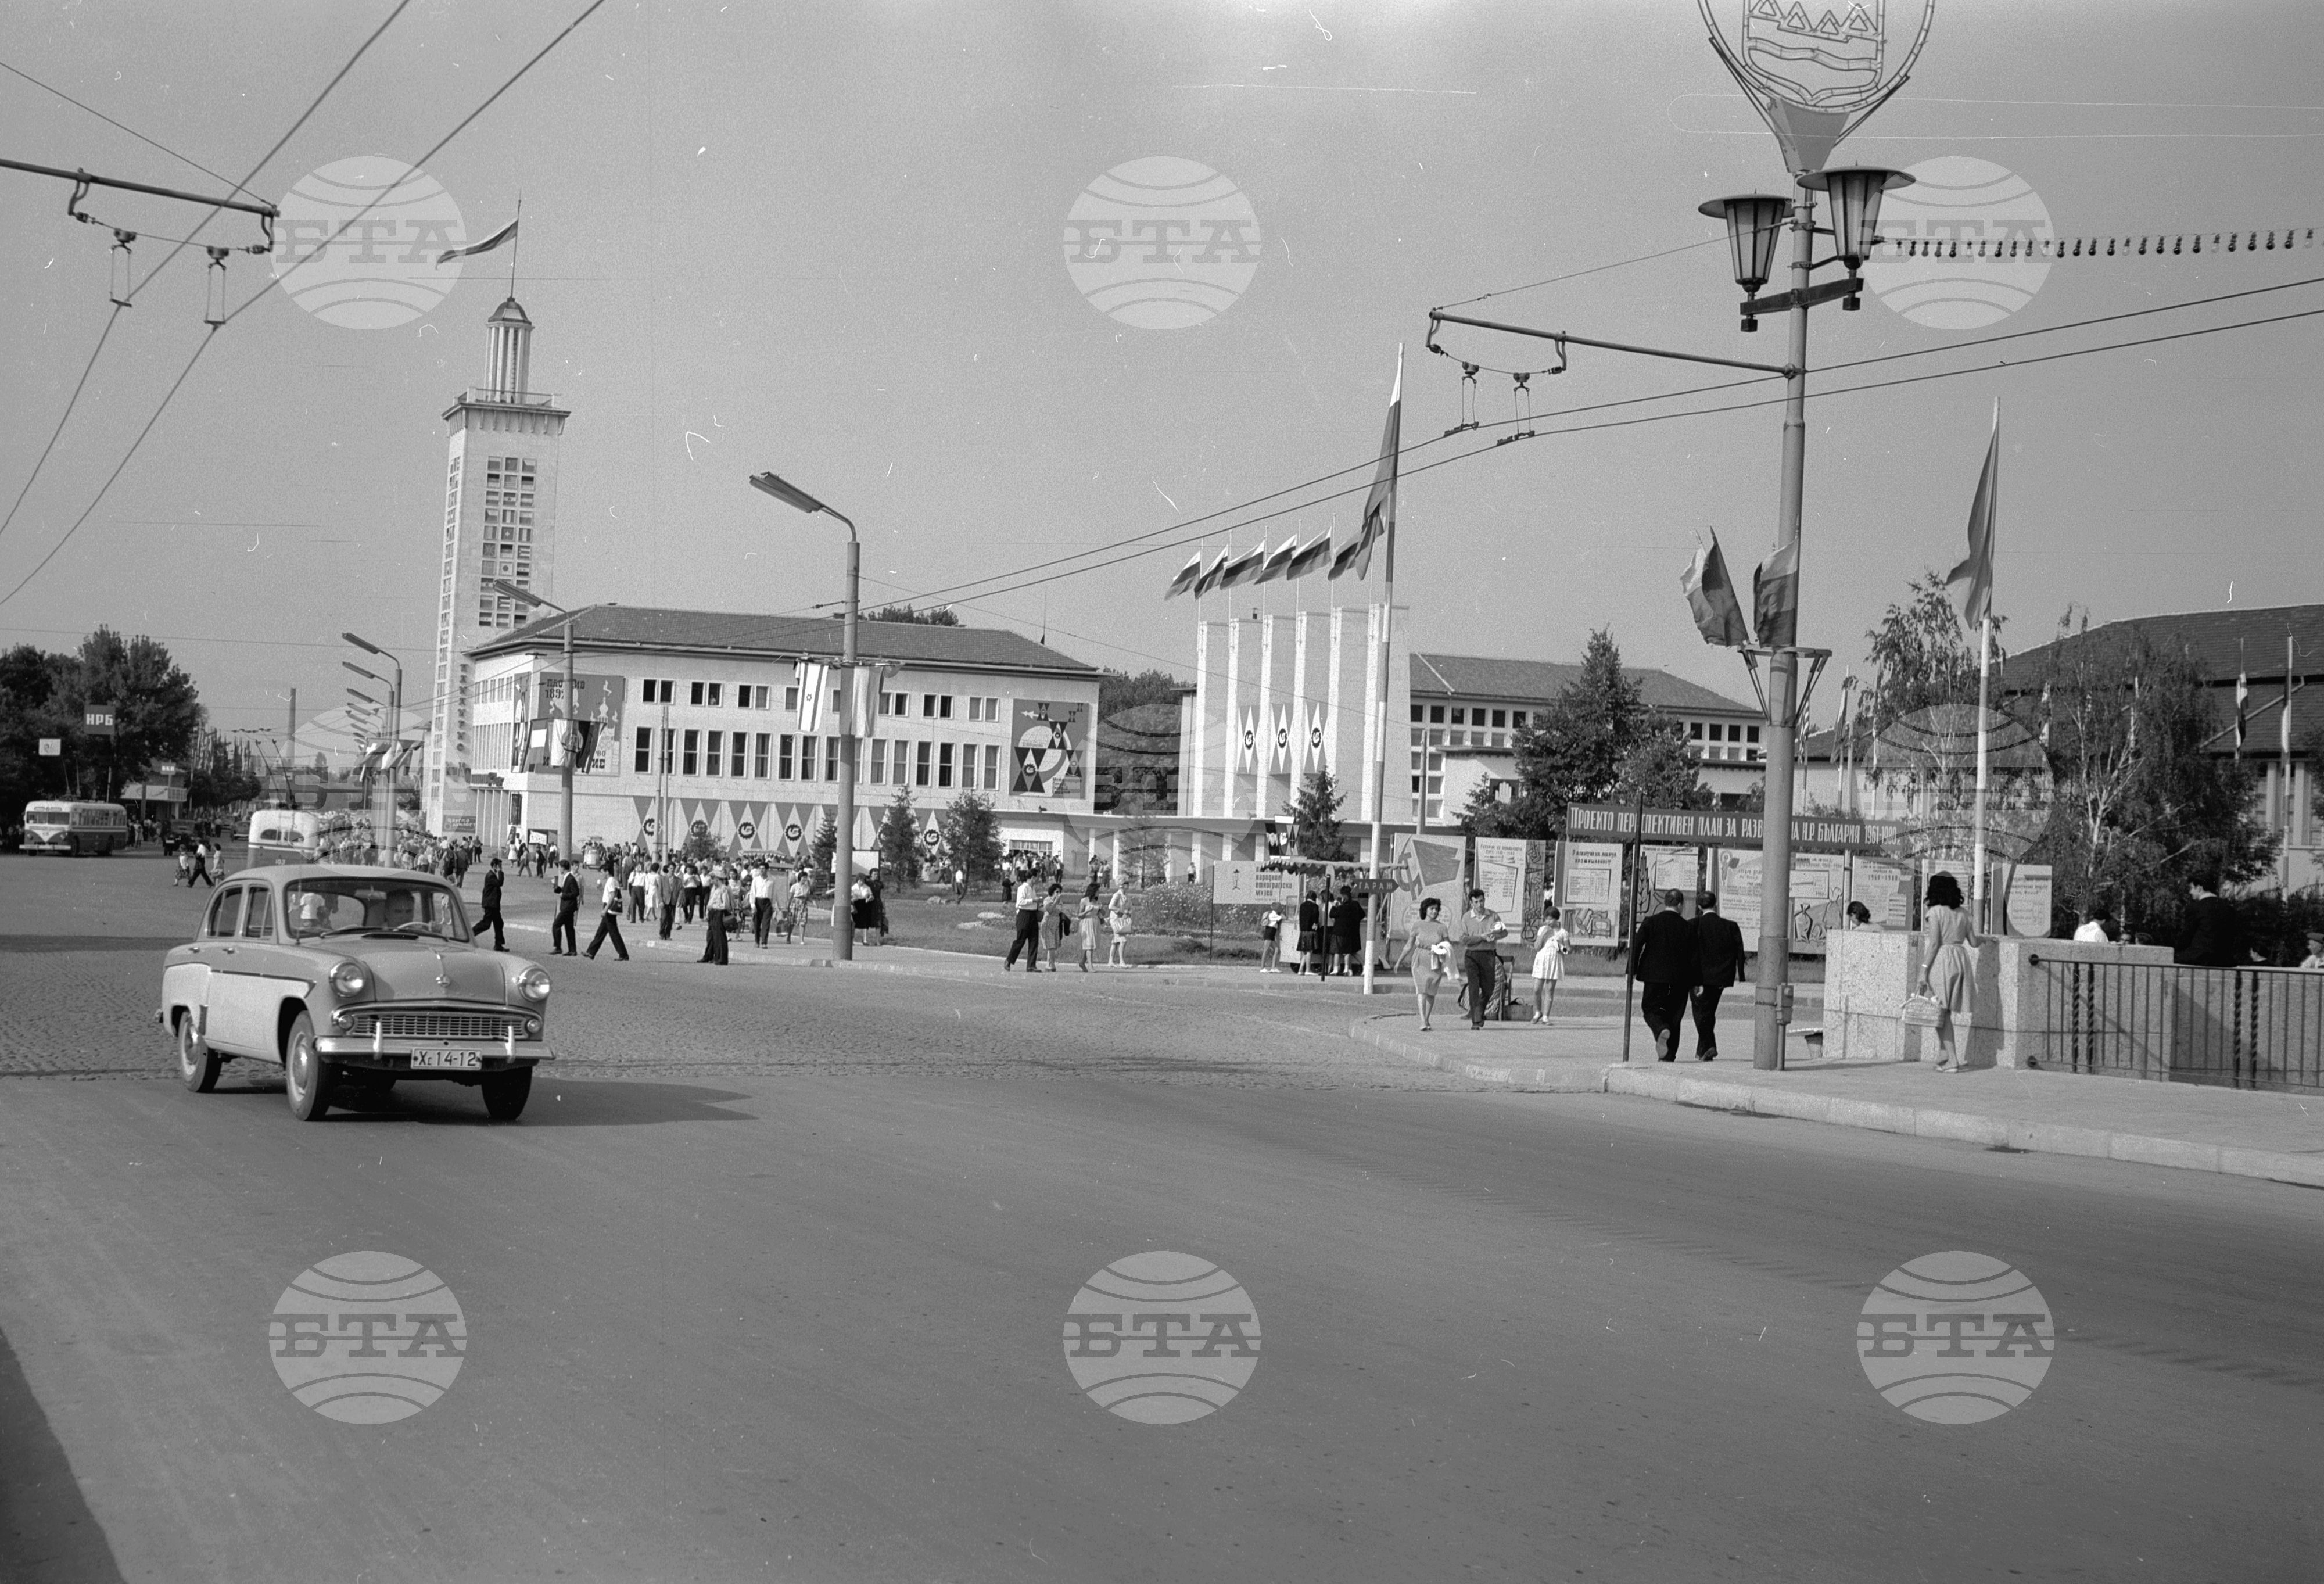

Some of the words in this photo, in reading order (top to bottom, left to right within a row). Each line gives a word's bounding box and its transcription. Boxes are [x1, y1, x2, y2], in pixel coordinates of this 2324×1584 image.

[87, 714, 113, 725] НРБ
[1570, 807, 1614, 831] ПРОЕКТО
[1698, 816, 1723, 837] ПЛАН
[1725, 818, 1737, 837] ЗА
[1817, 823, 1860, 843] БЪЛГАРИЯ
[1359, 881, 1393, 890] ГАРАЖ
[437, 1051, 476, 1066] 14-12
